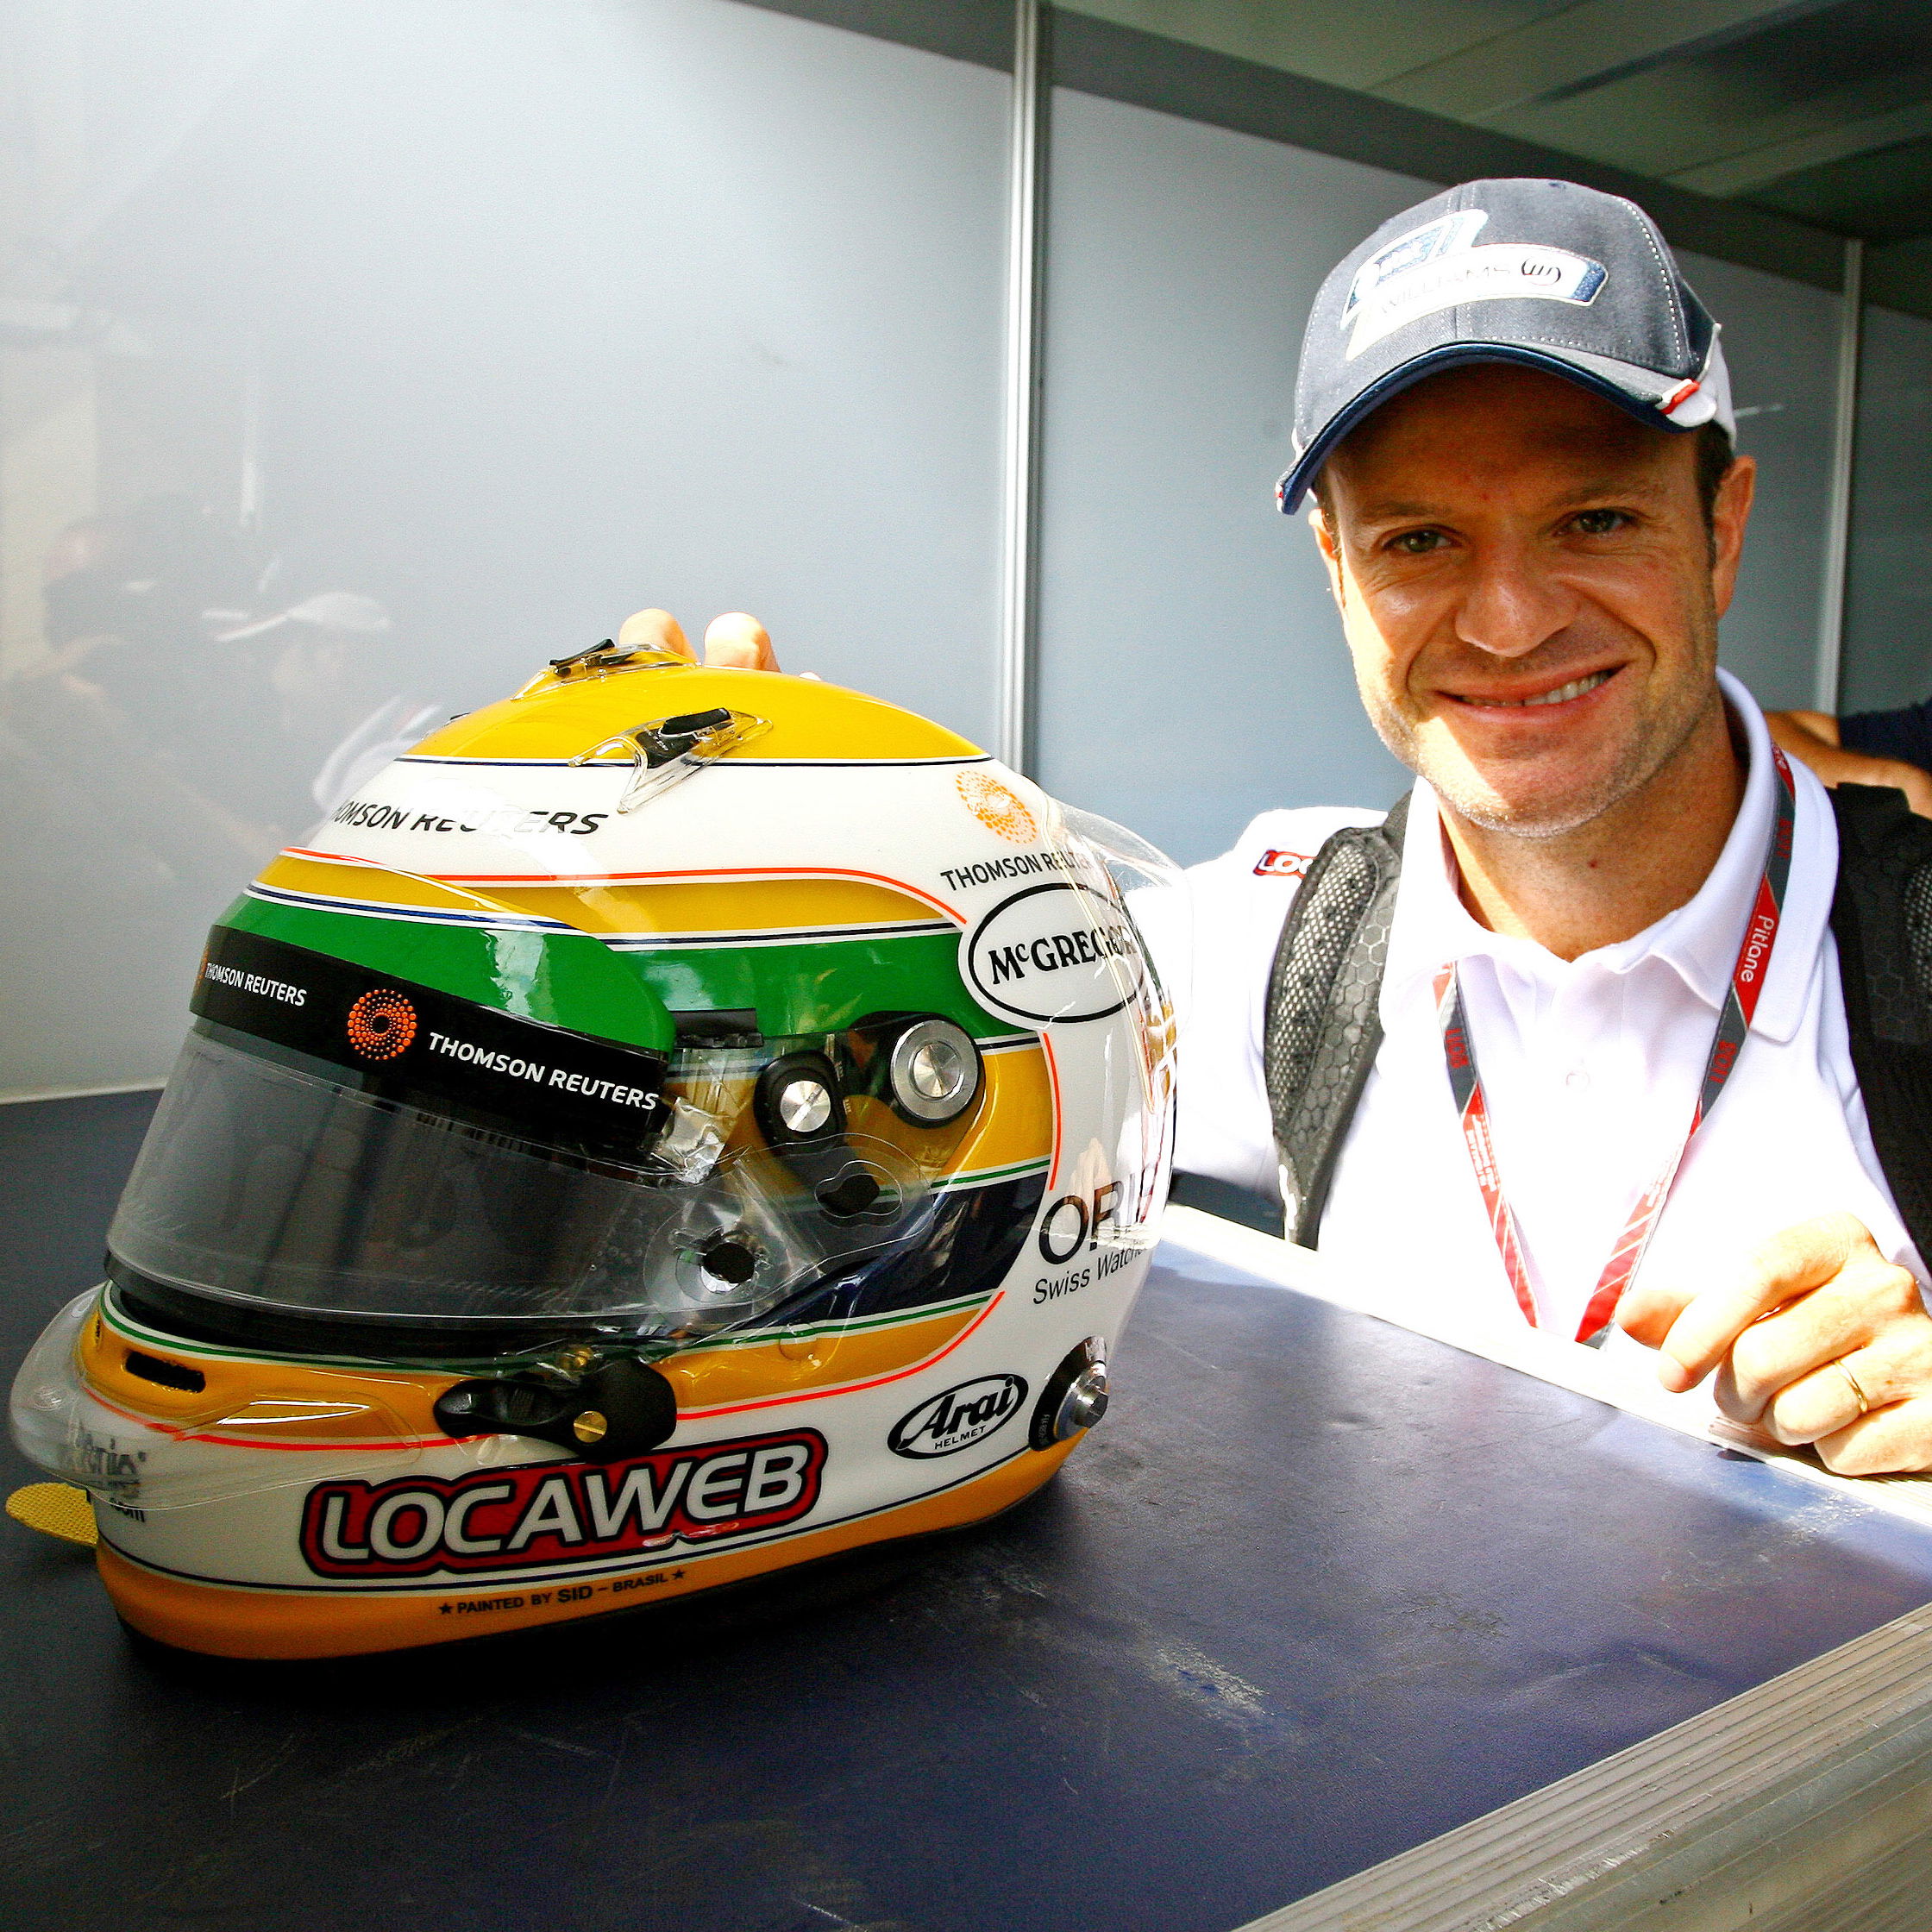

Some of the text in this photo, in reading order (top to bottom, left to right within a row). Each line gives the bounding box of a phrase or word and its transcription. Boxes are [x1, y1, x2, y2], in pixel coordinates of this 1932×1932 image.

[940, 853, 1043, 891] THOMSON
[1741, 914, 1775, 983] Pitlane
[206, 962, 308, 1007] THOMSON REUTERS
[429, 1032, 660, 1111] THOMSON REUTERS
[1032, 1268, 1091, 1305] Swiss
[899, 1376, 1015, 1450] Arai
[934, 1425, 987, 1450] HELMET
[323, 1444, 809, 1560] LOCAWEB
[456, 1596, 524, 1614] PAINTED
[530, 1591, 553, 1606] BY
[556, 1584, 593, 1604] SID
[612, 1572, 668, 1593] BRASIL
